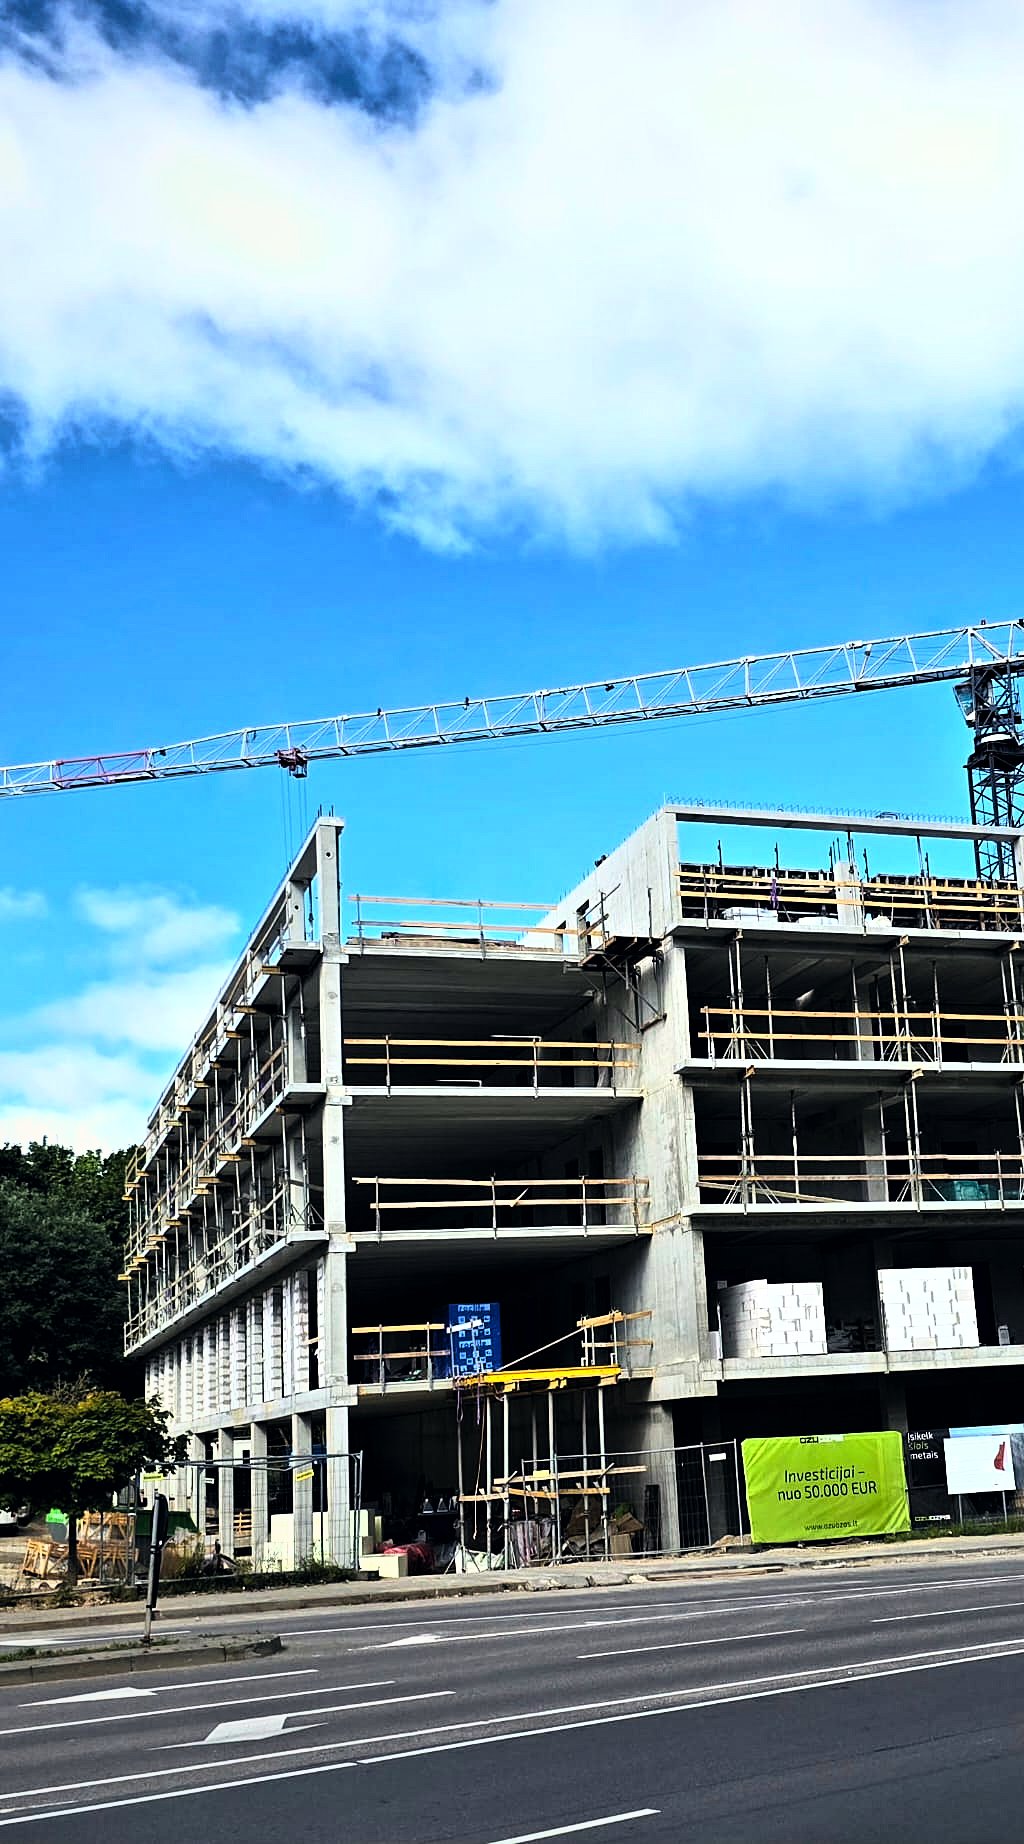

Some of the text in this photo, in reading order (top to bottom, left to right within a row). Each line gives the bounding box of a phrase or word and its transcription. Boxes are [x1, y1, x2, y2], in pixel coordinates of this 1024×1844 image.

[910, 1450, 939, 1460] metais
[784, 1465, 855, 1483] Investicijai
[777, 1480, 878, 1501] nuo 50.000 EUR
